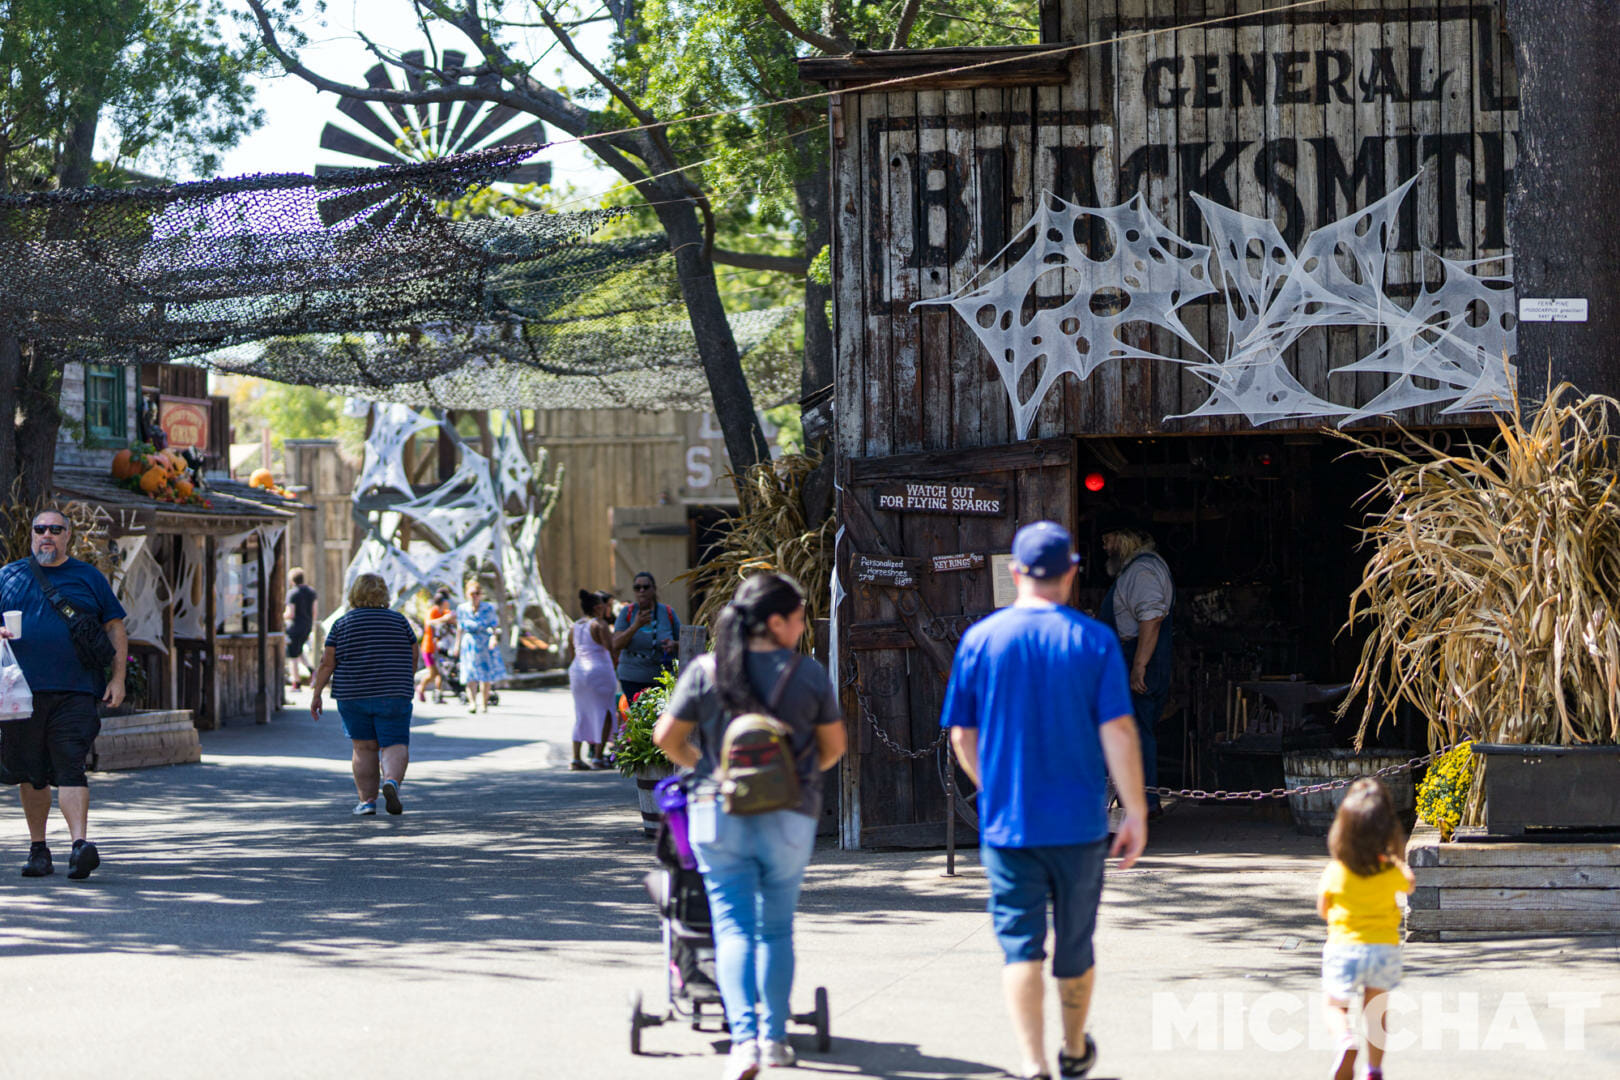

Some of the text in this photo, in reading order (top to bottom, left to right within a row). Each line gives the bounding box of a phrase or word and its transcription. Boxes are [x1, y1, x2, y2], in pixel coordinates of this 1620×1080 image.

[1143, 47, 1455, 108] GENERAL
[906, 484, 975, 499] WATCH OUT
[880, 495, 1000, 512] FOR FLYING SPARKS
[72, 502, 146, 531] JAIL
[934, 558, 971, 569] KEY RINGS
